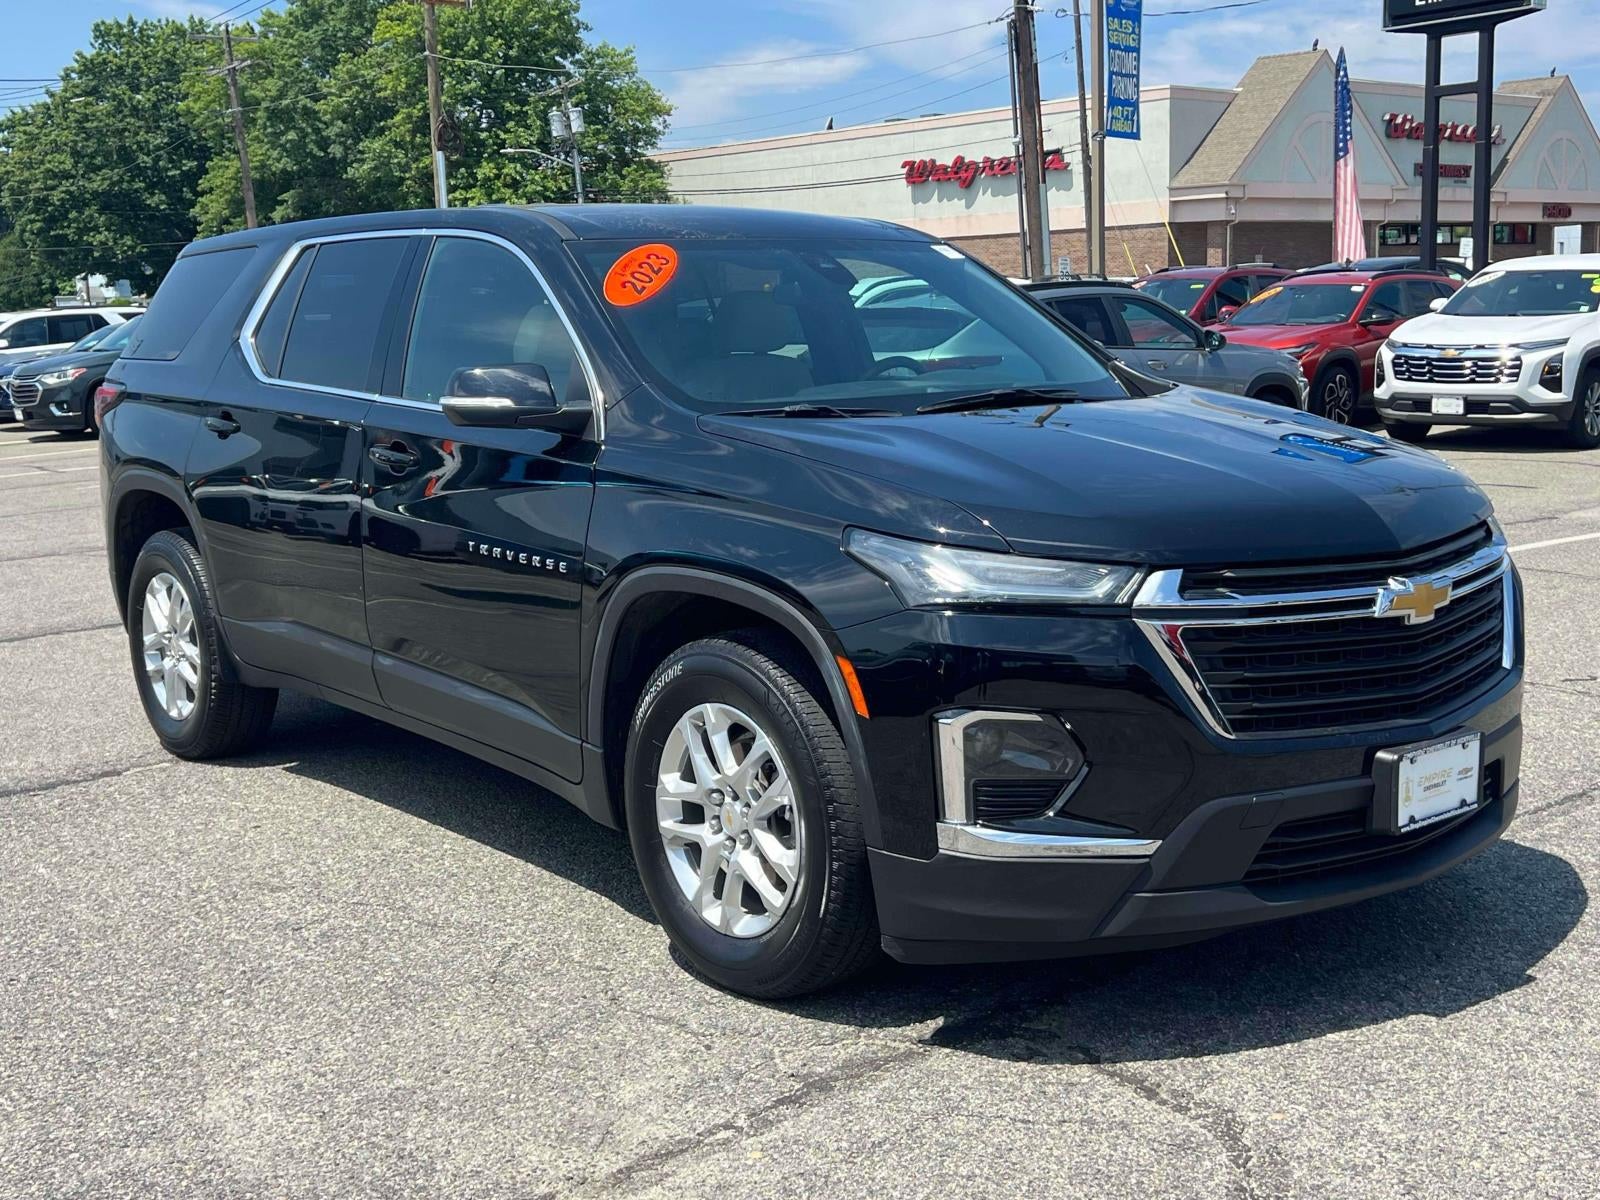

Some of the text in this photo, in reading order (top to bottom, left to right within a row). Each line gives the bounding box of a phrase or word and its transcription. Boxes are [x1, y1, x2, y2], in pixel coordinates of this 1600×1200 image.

[1108, 17, 1132, 33] SALES
[1112, 75, 1138, 102] PARKING
[1383, 113, 1505, 145] Warees
[901, 153, 1070, 188] Walgres
[1414, 163, 1473, 178] PRMACY
[620, 252, 670, 296] 2023
[467, 540, 568, 574] TRAVERSE
[1417, 767, 1454, 787] EMPIRE
